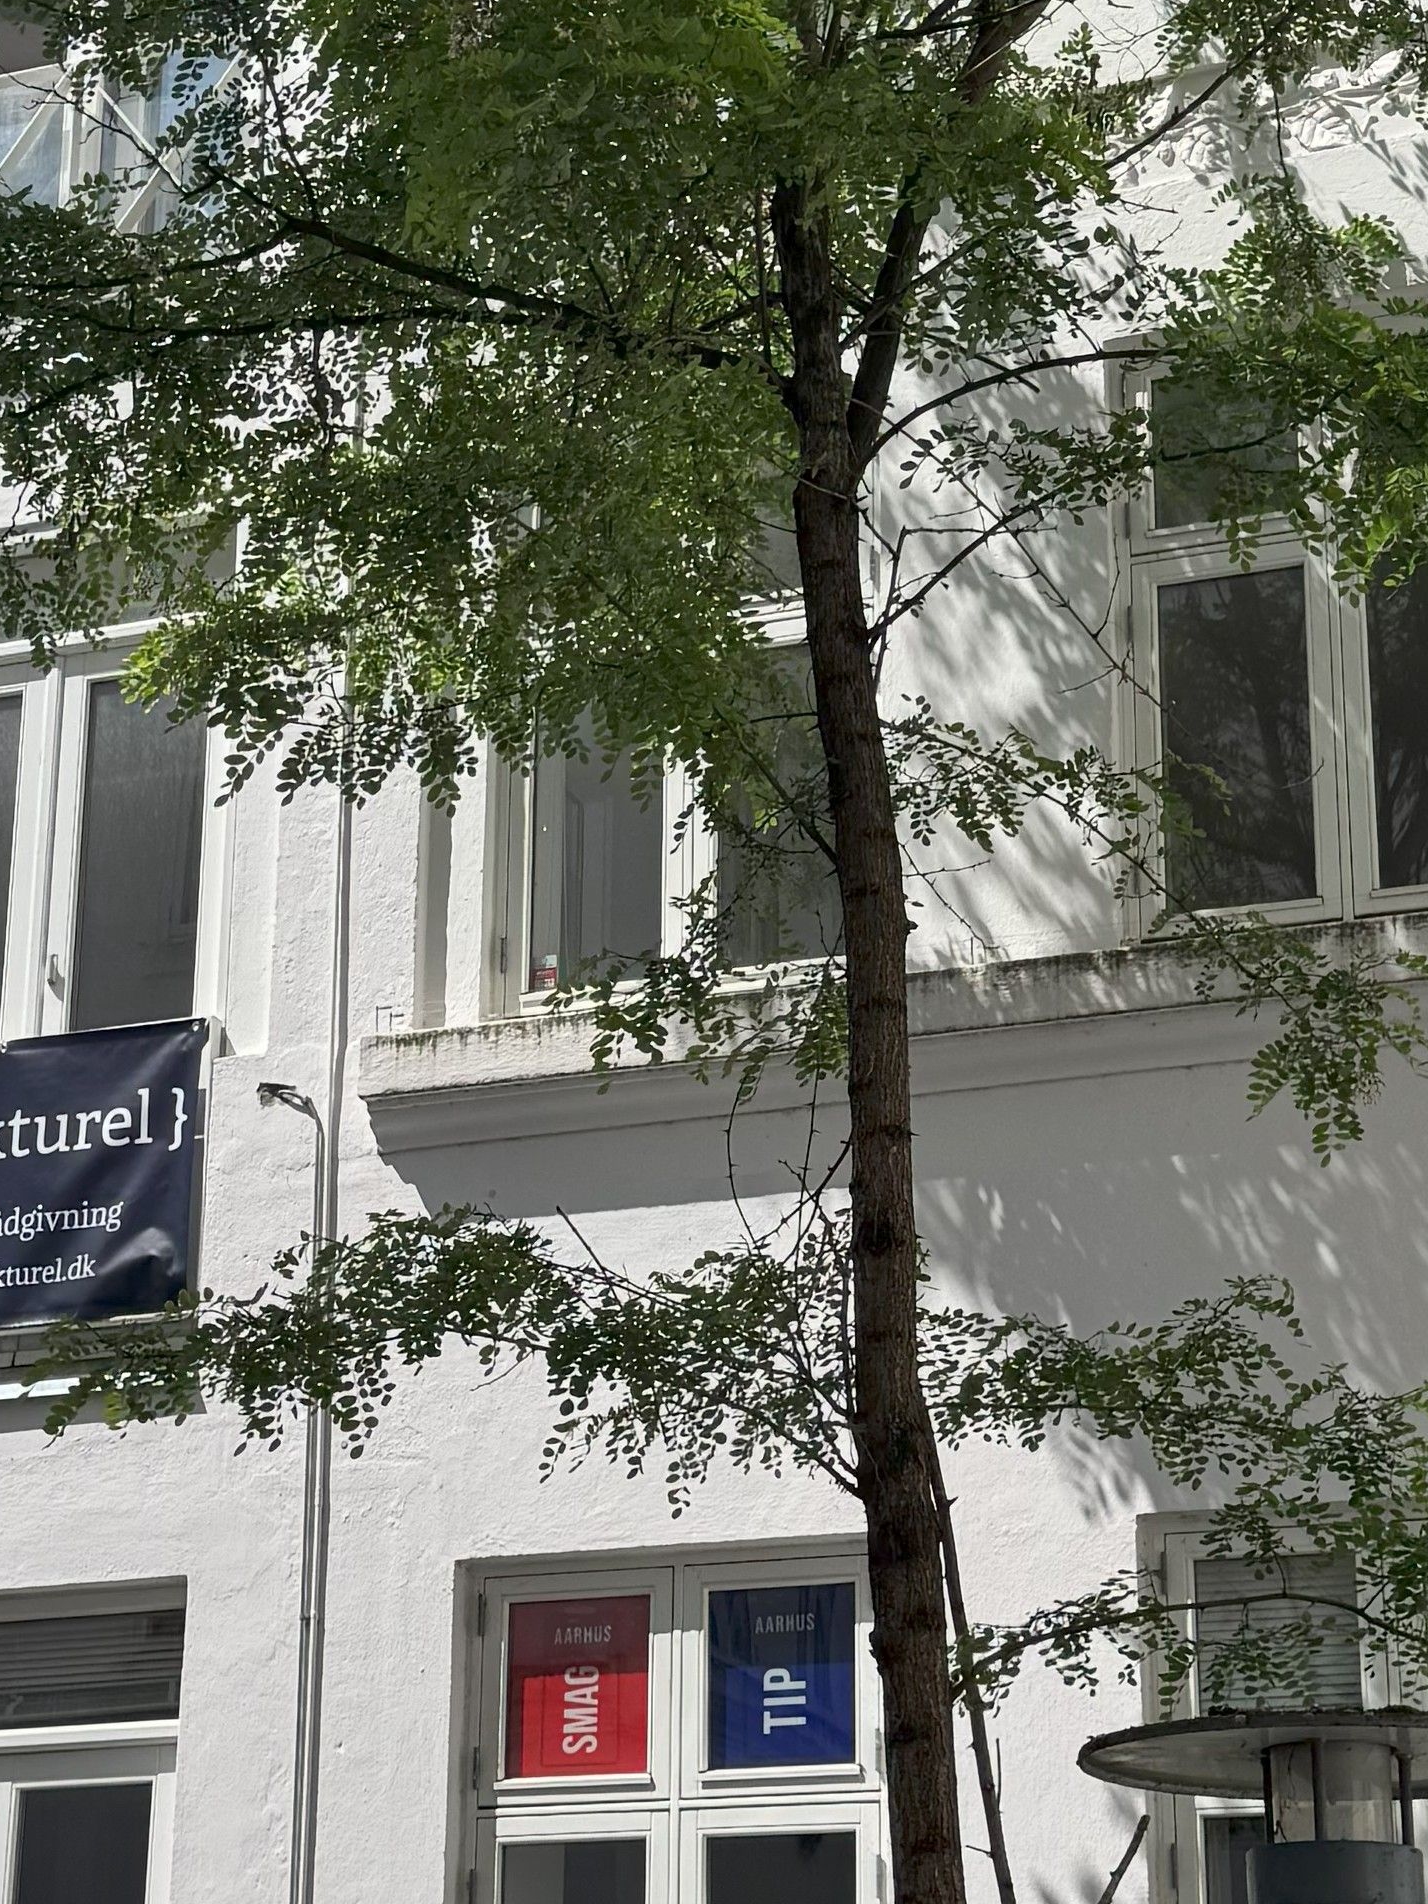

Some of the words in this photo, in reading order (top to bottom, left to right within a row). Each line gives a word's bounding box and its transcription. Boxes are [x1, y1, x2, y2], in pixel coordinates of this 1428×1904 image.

[554, 1624, 612, 1646] AARHUS
[755, 1612, 815, 1634] AARHUS
[562, 1665, 600, 1754] SMAG
[763, 1667, 807, 1735] TIP
